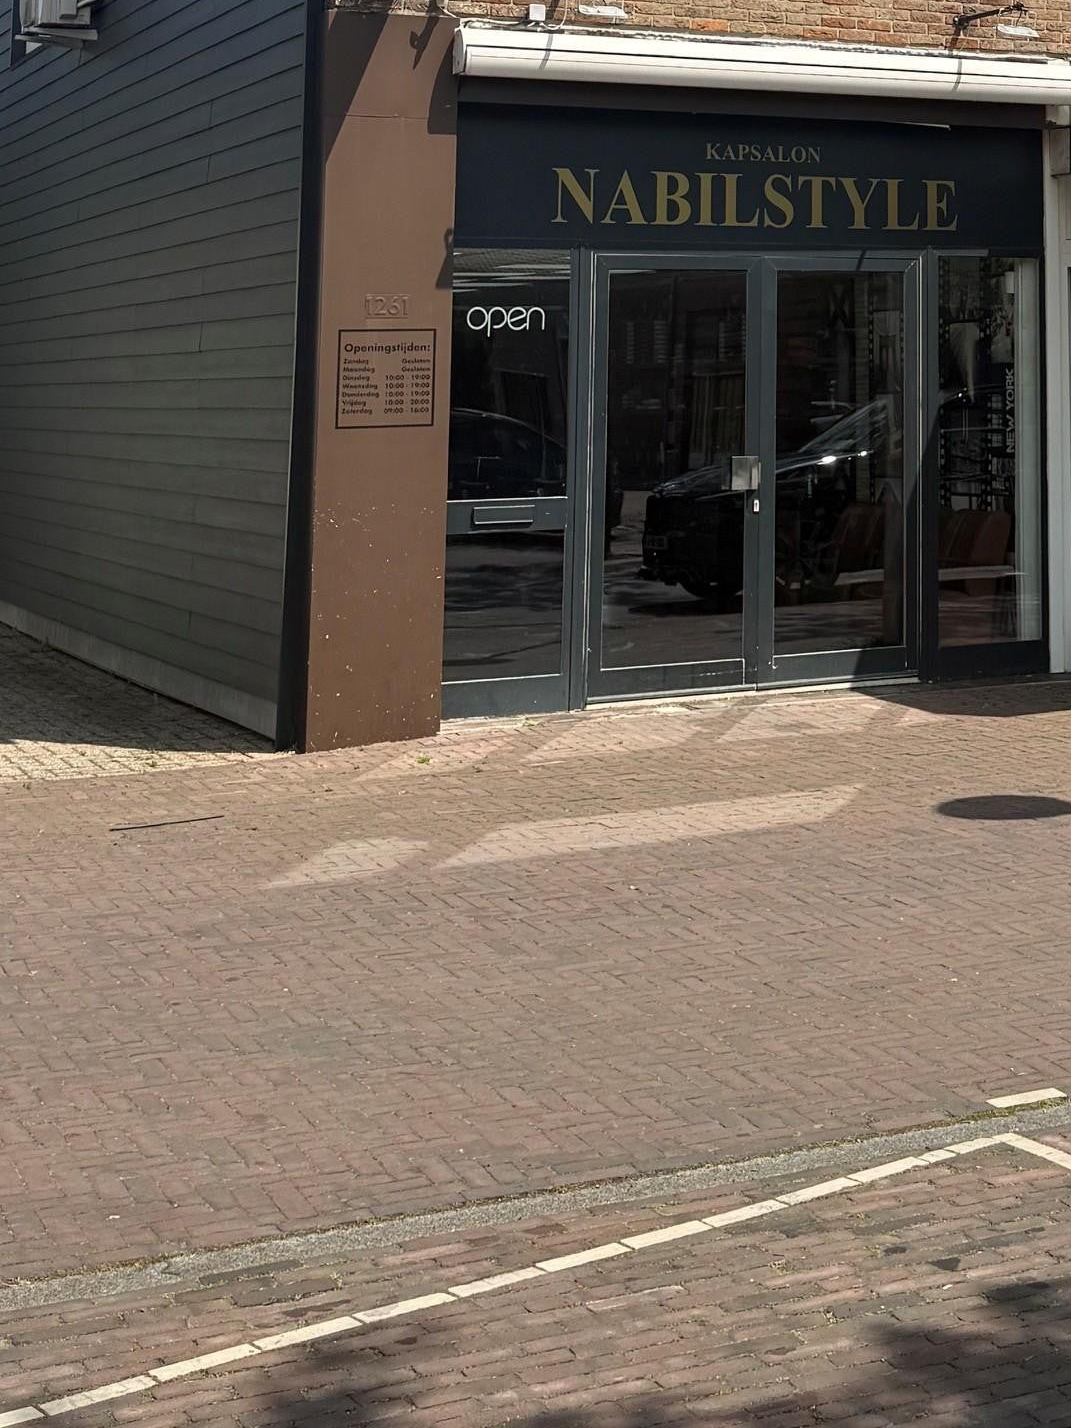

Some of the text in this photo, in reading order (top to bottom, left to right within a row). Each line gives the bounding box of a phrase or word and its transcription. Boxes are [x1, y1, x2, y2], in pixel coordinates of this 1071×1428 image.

[705, 142, 821, 164] KAPSALON
[551, 167, 959, 232] NABILSTYLE
[466, 306, 545, 338] open
[344, 342, 431, 354] Openingstijden:
[342, 399, 366, 407] Vrijdag
[1005, 368, 1015, 453] NEW YORK
